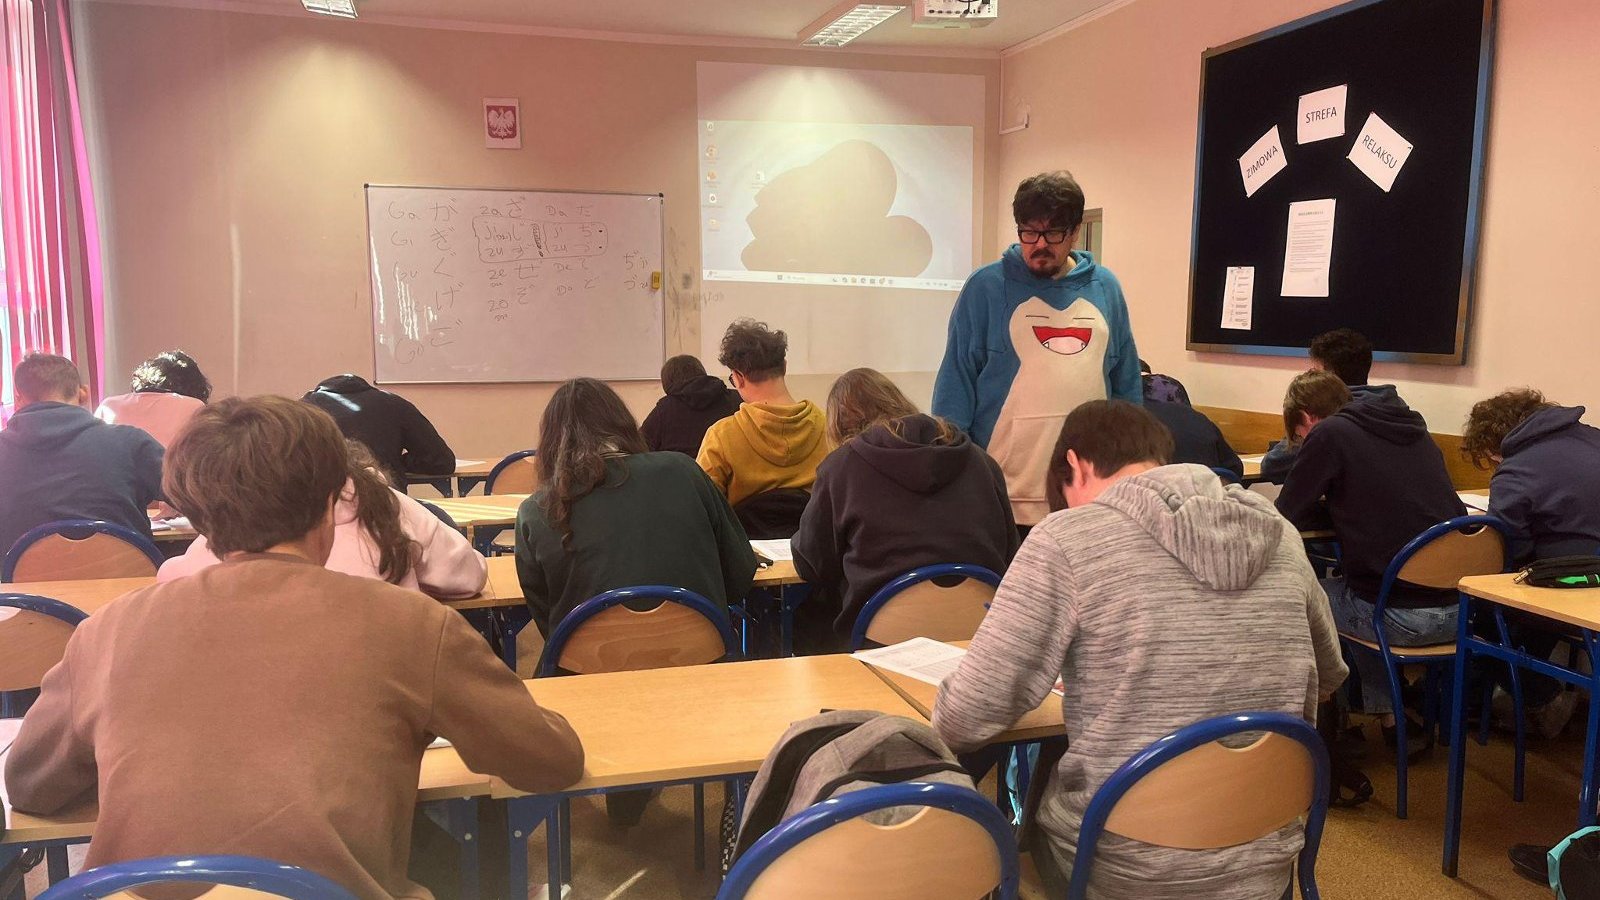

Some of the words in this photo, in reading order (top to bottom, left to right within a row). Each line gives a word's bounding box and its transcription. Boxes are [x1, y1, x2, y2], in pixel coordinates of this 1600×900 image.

[1305, 106, 1337, 124] STREFA
[1246, 145, 1279, 179] ZIMOWA
[1362, 134, 1398, 170] RELAKSU
